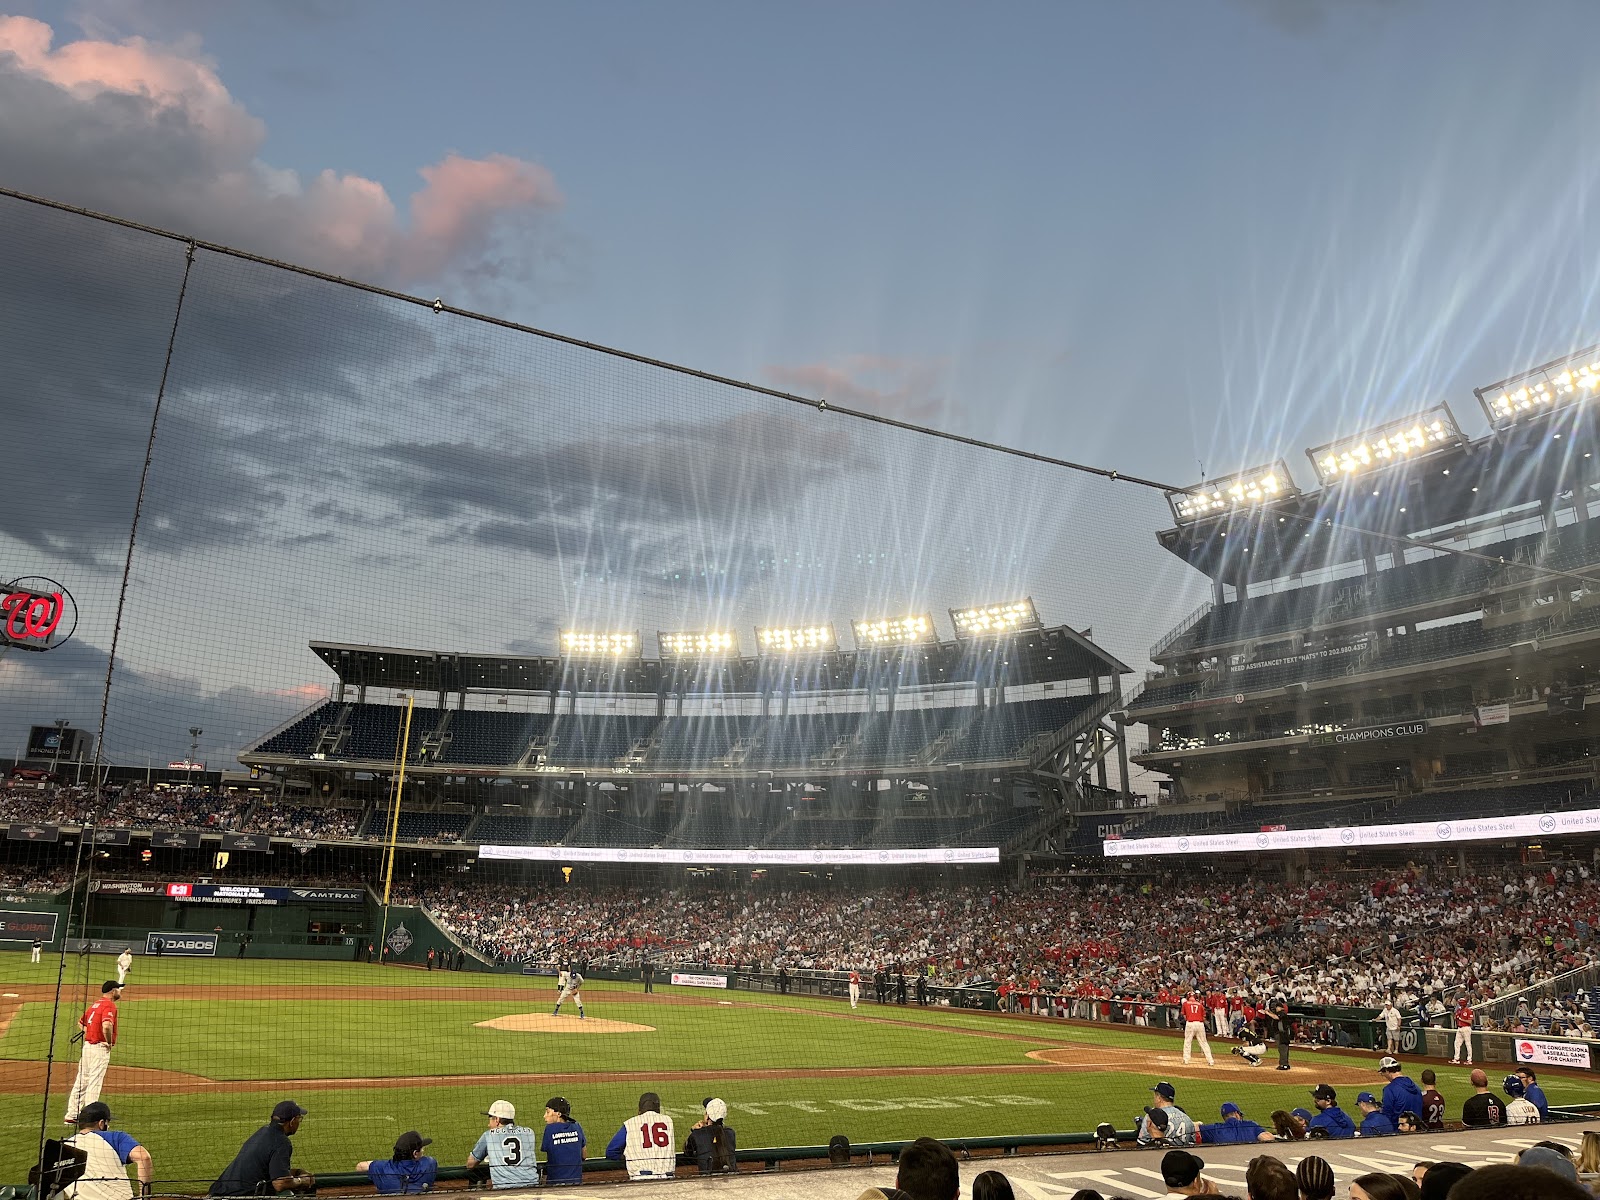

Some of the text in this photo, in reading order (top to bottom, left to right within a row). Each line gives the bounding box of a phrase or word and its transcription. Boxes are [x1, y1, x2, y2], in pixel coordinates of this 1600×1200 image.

[1230, 665, 1245, 673] NEED
[1245, 658, 1282, 670] ASSISTANCE?
[1283, 656, 1298, 664] TEXT
[1299, 652, 1319, 661] "NATS"
[1319, 650, 1328, 658] TO
[1335, 728, 1394, 743] CHAMPIONS
[1396, 724, 1424, 736] CLUB
[1561, 817, 1584, 826] United
[1399, 829, 1415, 837] Steel
[1456, 825, 1476, 834] United
[1477, 824, 1497, 832] States
[1499, 822, 1516, 830] Steel
[1290, 835, 1307, 843] States
[102, 882, 143, 890] WASHINGTON
[120, 886, 155, 894] NATIONALS
[170, 885, 188, 895] 8:31
[202, 896, 242, 904] PHILANTHROPIES
[7, 922, 49, 933] GLOBAL
[166, 940, 214, 950] DABOS
[1190, 1004, 1199, 1014] 17
[1428, 1104, 1445, 1123] 23
[640, 1122, 670, 1149] 16
[1166, 1121, 1187, 1143] 24
[502, 1136, 522, 1166] 3
